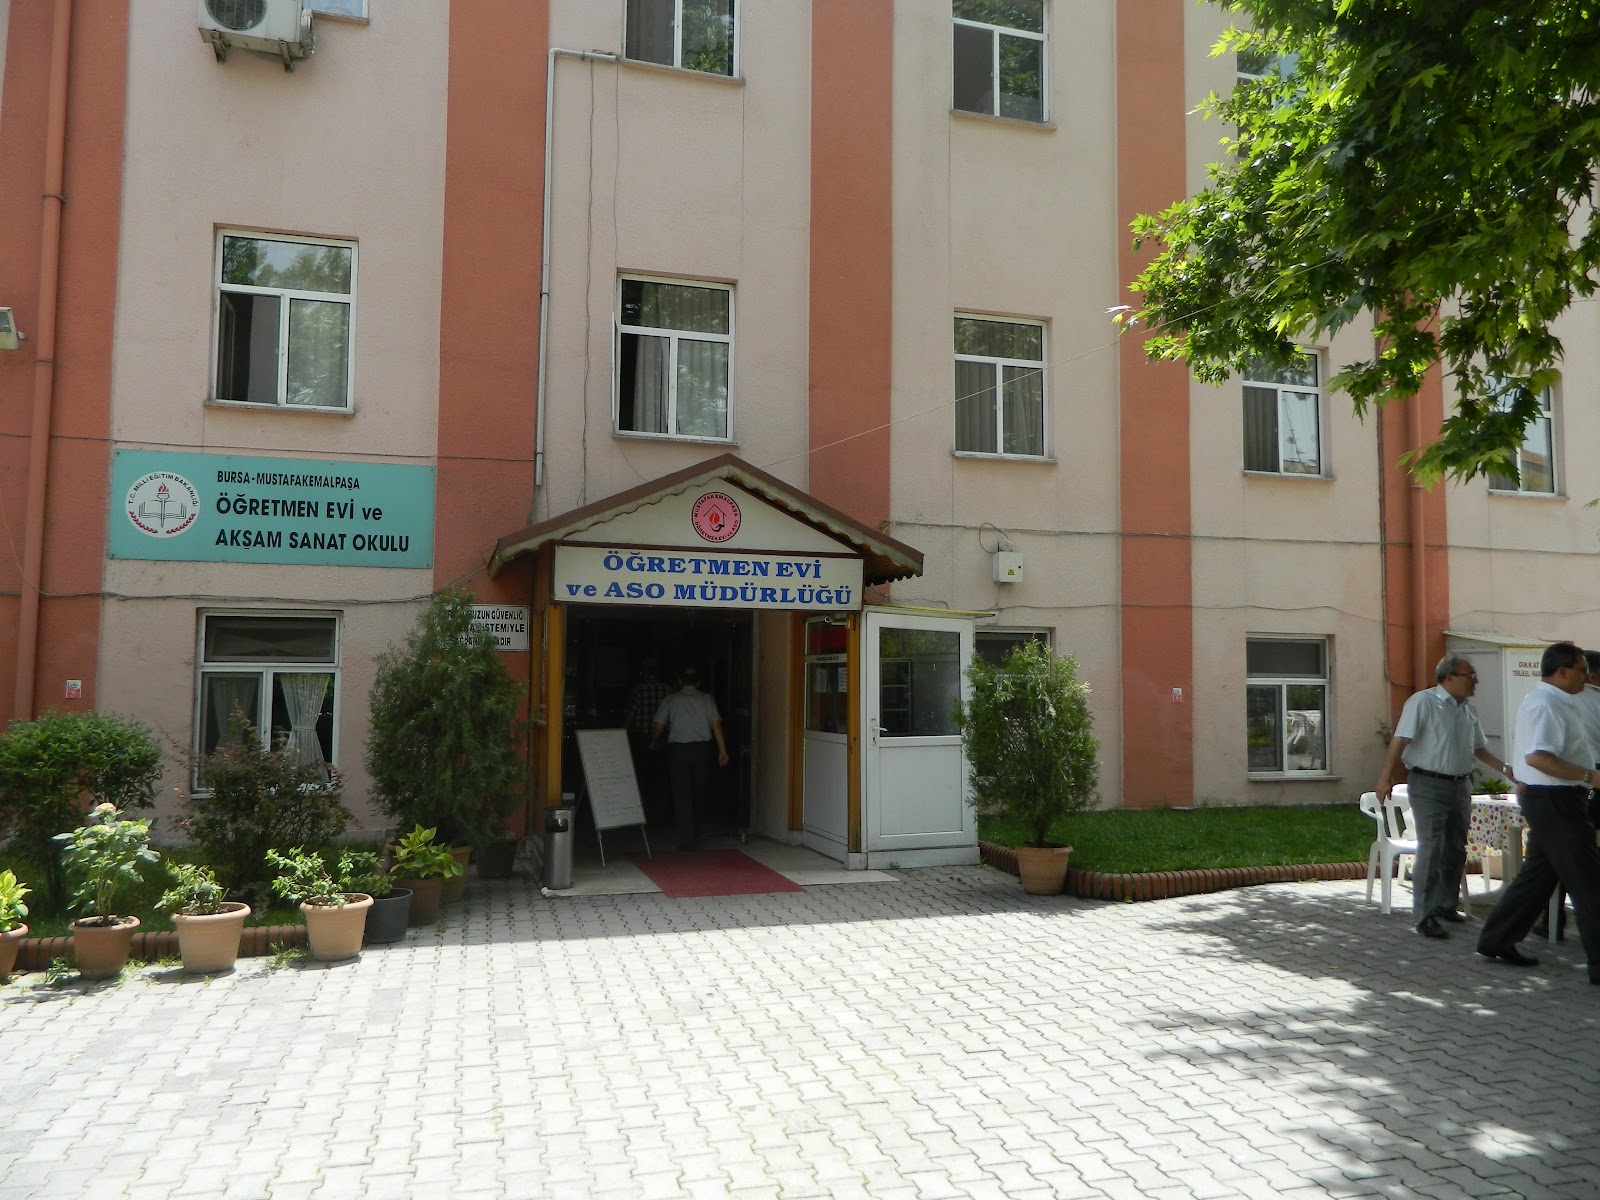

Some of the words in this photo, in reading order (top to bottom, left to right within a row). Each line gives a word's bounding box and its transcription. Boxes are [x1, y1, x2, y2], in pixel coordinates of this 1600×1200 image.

[216, 492, 319, 517] ÖĞRETMEN
[326, 498, 354, 519] EVİ
[362, 507, 383, 521] ve
[215, 528, 282, 550] AKŞAM
[289, 531, 347, 550] SANAT
[352, 533, 409, 552] OKULU
[603, 550, 770, 577] ÖĞRETMEN
[776, 560, 822, 578] EVİ
[566, 584, 597, 597] ve
[604, 582, 665, 599] ASO
[673, 581, 852, 605] MÜDÜRLÜĞÜ
